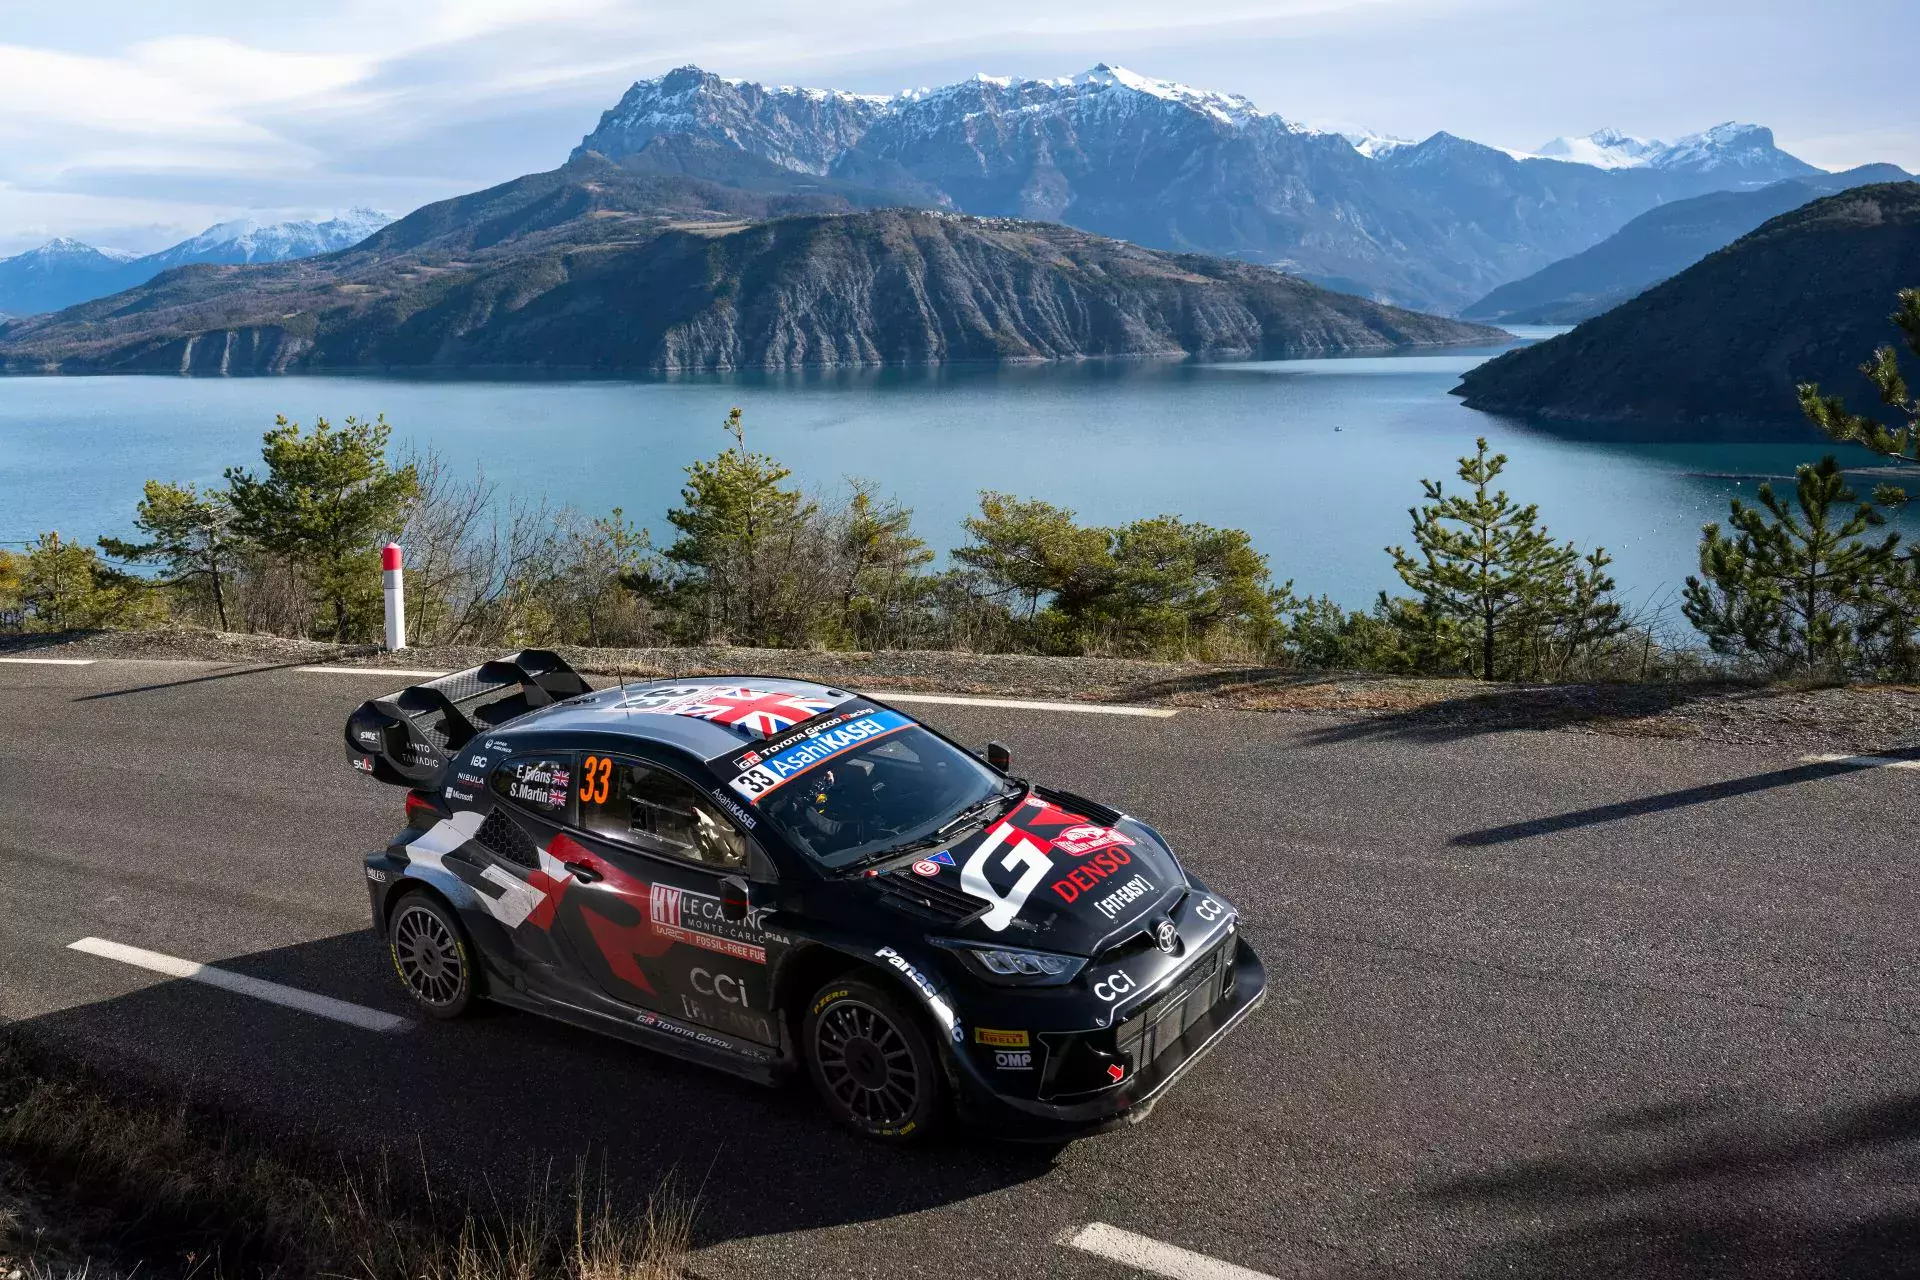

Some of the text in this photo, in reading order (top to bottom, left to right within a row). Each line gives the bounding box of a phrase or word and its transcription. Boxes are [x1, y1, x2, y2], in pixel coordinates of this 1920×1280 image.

[760, 733, 806, 756] TOYOTA
[804, 717, 842, 736] GAZOO
[772, 718, 886, 777] AsahiKASEI
[402, 753, 439, 768] TAMADIC
[457, 772, 484, 784] NISULA
[516, 764, 551, 784] E.Evans
[580, 756, 612, 804] 33
[737, 769, 775, 793] 33
[453, 790, 474, 802] Microsoft
[509, 782, 548, 803] S.Martin
[711, 788, 757, 830] AsahiKASEI
[1051, 846, 1132, 904] DENSO
[682, 896, 768, 931] LE CAN
[696, 935, 748, 957] FOSSIL-FREE
[819, 989, 849, 1006] ZERO
[874, 945, 965, 1043] Panasic
[656, 1020, 695, 1039] TOYOTA
[996, 1053, 1033, 1067] OMP
